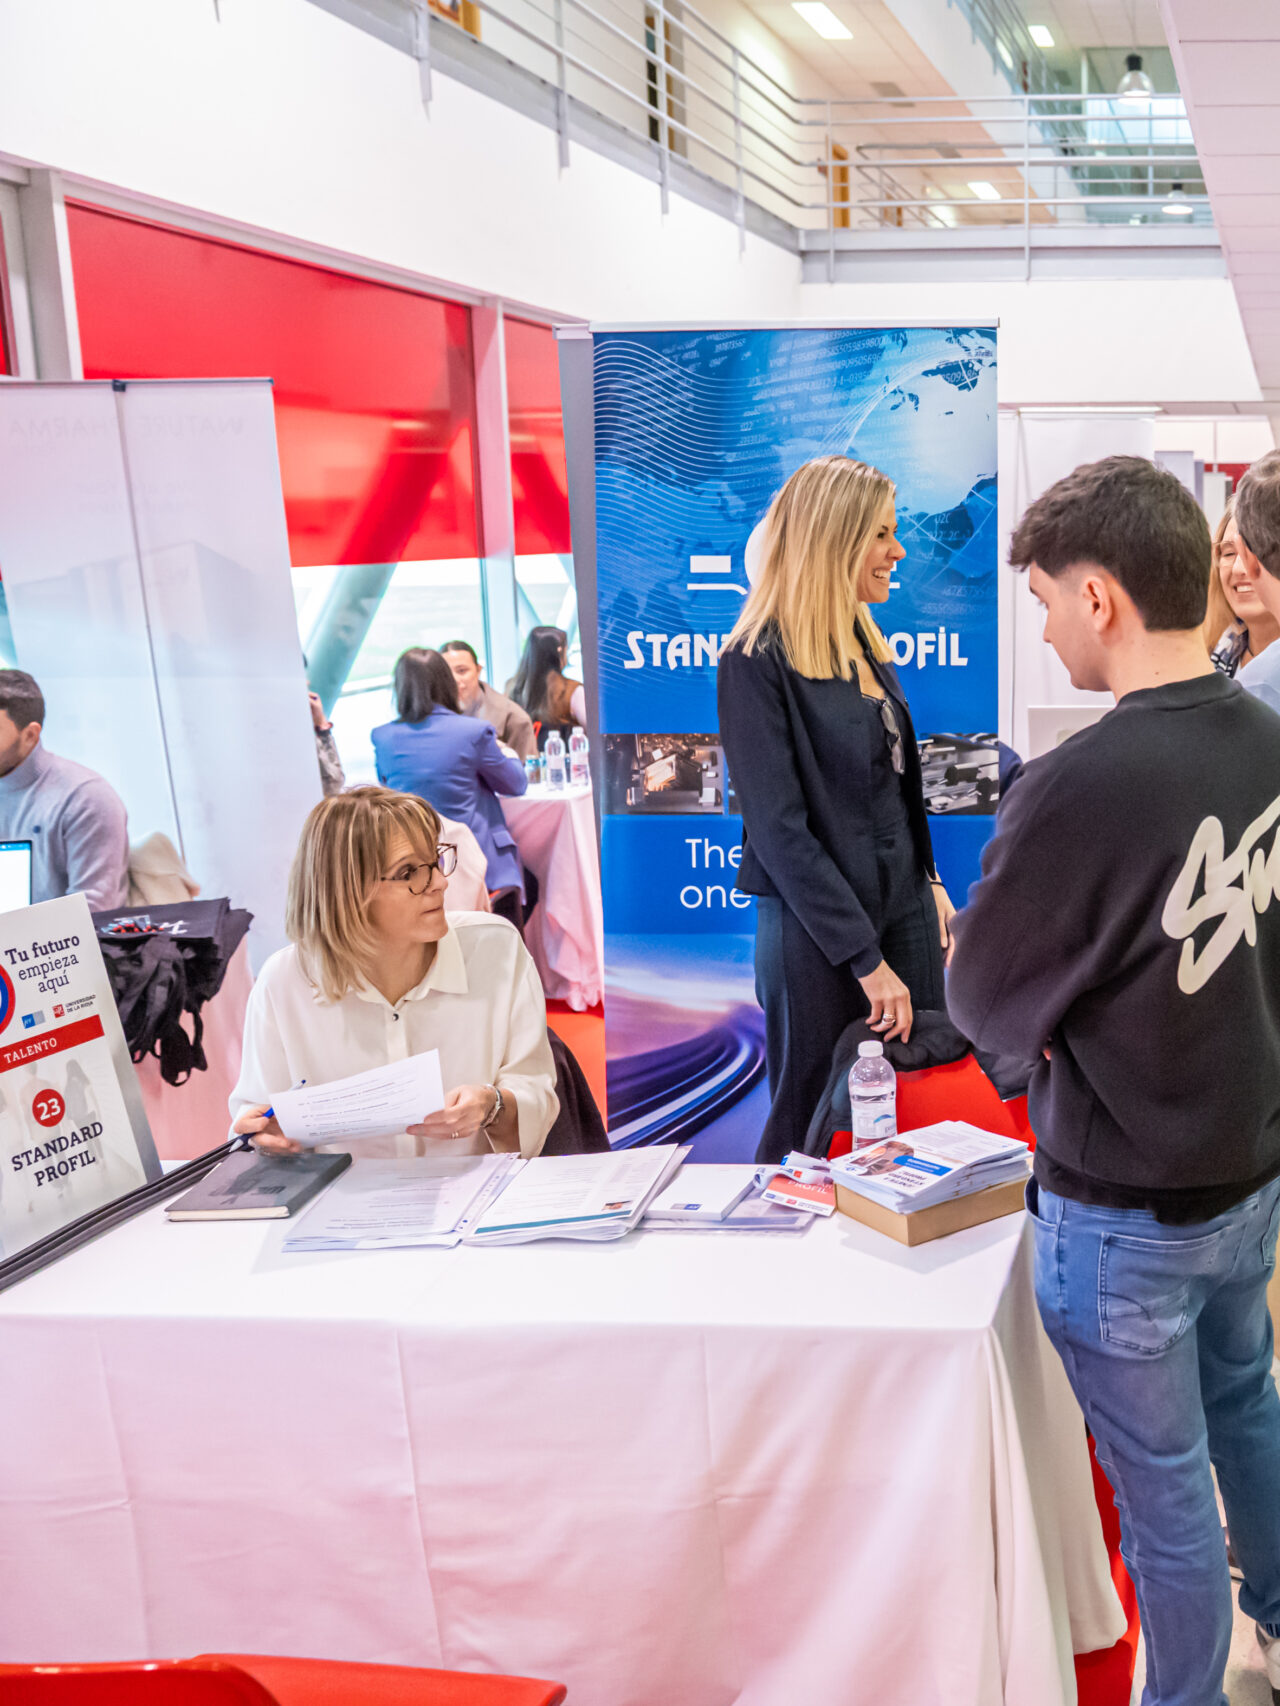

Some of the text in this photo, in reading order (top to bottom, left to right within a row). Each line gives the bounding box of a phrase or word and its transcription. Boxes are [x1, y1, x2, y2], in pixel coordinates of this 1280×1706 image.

[684, 837, 743, 869] The
[4, 935, 80, 965] Tu futuro
[18, 953, 79, 981] empieza
[38, 970, 70, 994] aquí
[65, 994, 96, 1008] UNIVERSIDAD
[3, 1037, 58, 1064] TALENTO
[37, 1098, 61, 1121] 23
[11, 1121, 104, 1172] STANDARD
[34, 1150, 96, 1187] PROFIL
